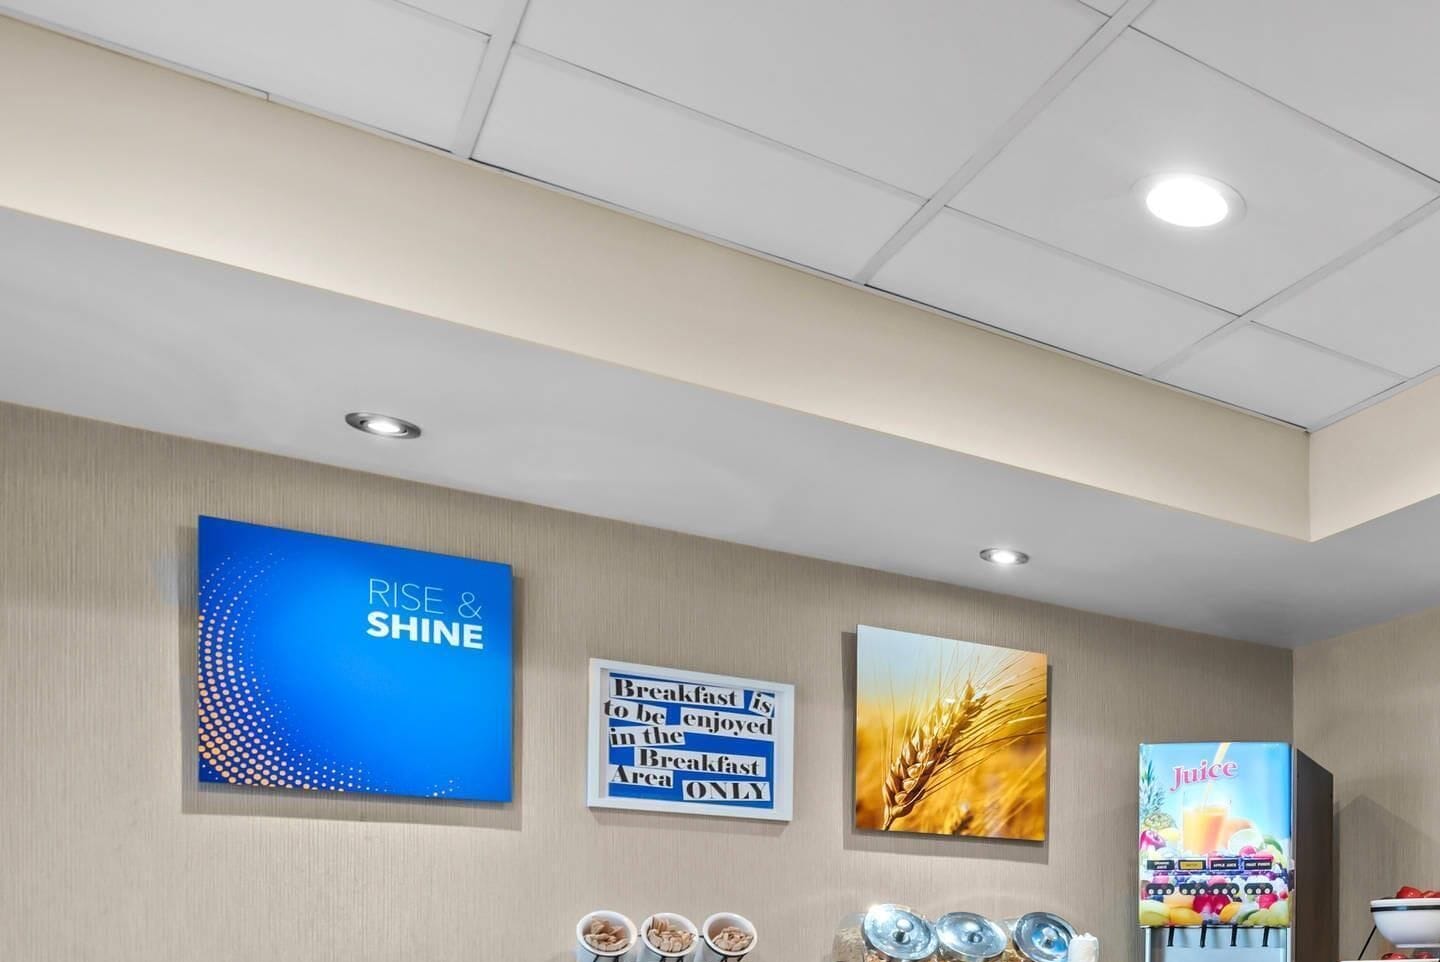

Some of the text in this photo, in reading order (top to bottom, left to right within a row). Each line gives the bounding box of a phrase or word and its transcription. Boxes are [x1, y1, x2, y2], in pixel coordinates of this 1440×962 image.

[369, 578, 482, 620] RISE &
[366, 611, 484, 650] SHINE
[615, 678, 773, 714] Breakfast is
[604, 700, 773, 736] to be enjoyed
[610, 726, 683, 746] in the
[639, 749, 760, 776] Breakfast
[1169, 759, 1238, 792] Juice
[611, 765, 767, 799] Area ONLY
